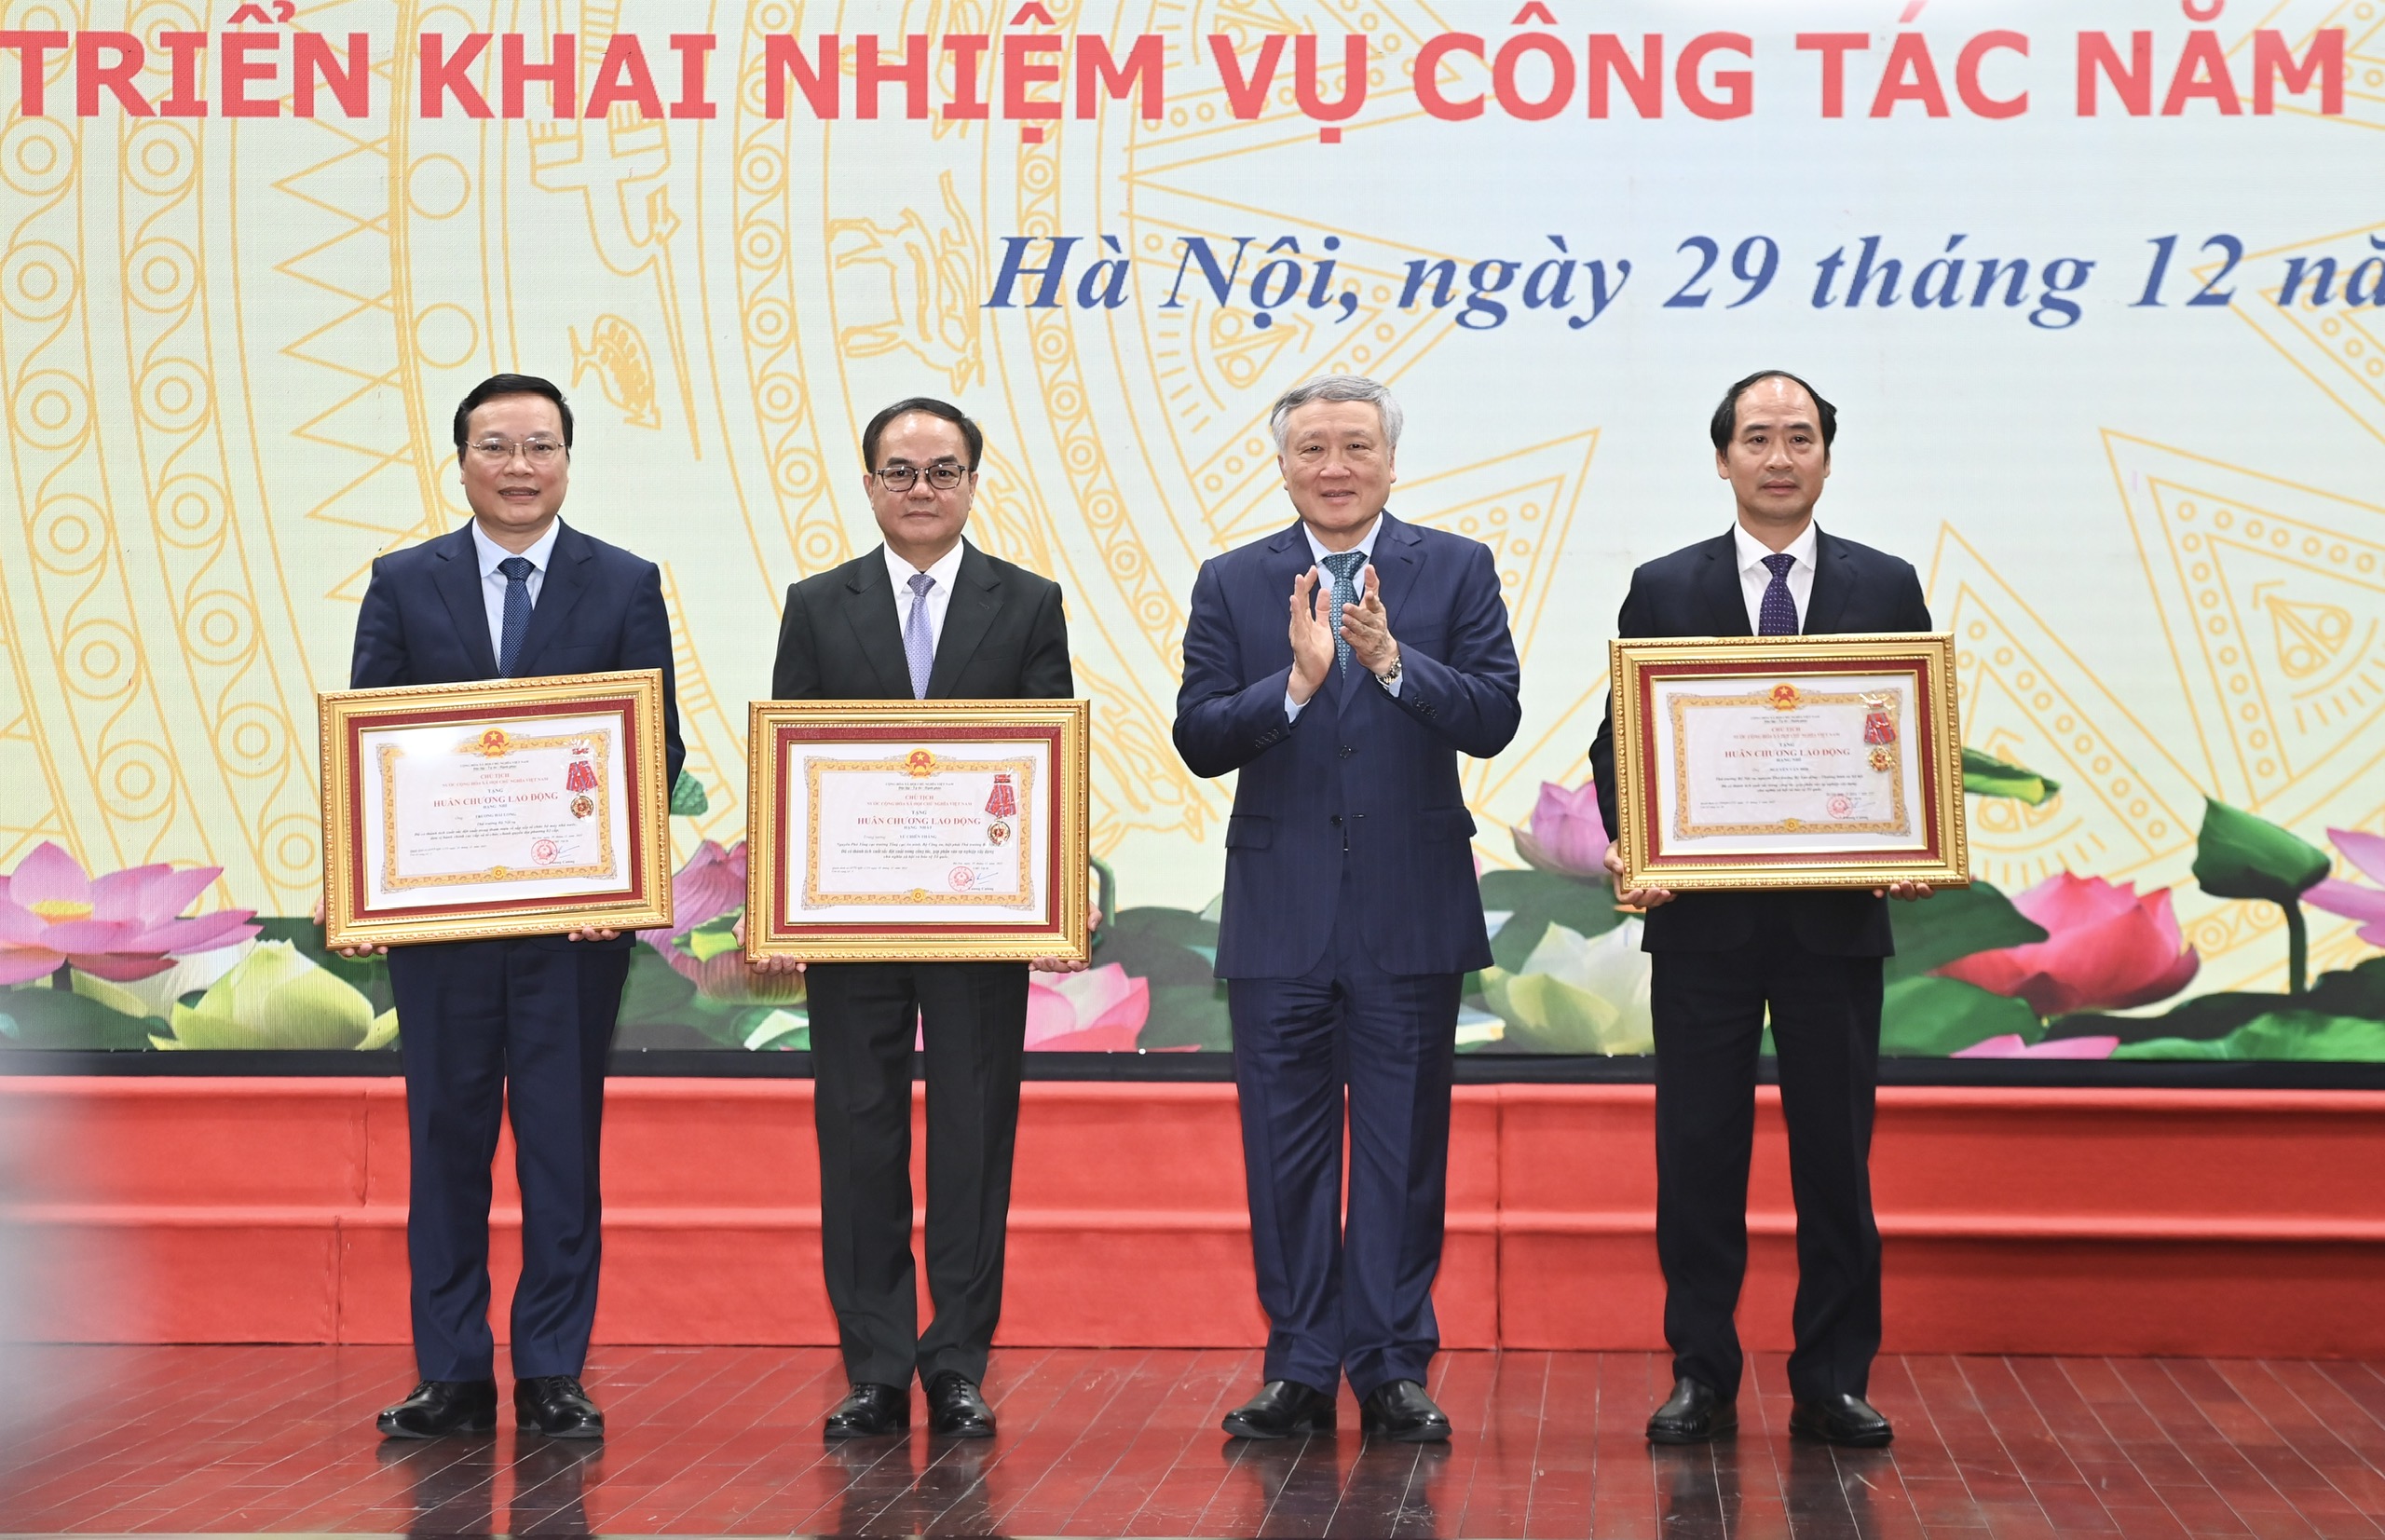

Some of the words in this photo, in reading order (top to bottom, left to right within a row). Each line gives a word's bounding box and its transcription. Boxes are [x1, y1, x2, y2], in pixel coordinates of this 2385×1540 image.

[0, 0, 370, 118] TRIỂN
[418, 33, 717, 119] KHAI
[764, 2, 1165, 143] NHIỆM
[1207, 34, 1369, 143] VỤ
[1411, 1, 1754, 121] CÔNG
[1795, 0, 2030, 119] TÁC
[2076, 0, 2346, 116] NĂM
[982, 234, 1130, 310] Hà
[1160, 235, 1359, 330] Nội,
[1397, 234, 1632, 330] ngày
[1662, 235, 1780, 309] 29
[1810, 234, 2096, 330] tháng
[2127, 234, 2245, 308] 12
[1724, 748, 1752, 758] HUÂN
[1754, 749, 1797, 757] CHƯƠNG
[1822, 748, 1850, 757] ĐỘNG
[433, 797, 460, 807] HUÂN
[463, 795, 506, 806] CHƯƠNG
[508, 794, 528, 803] LAO
[530, 791, 558, 802] ĐỘNG
[857, 815, 884, 825] HUÂN
[886, 816, 929, 825] CHƯƠNG
[931, 817, 951, 825] LAO
[953, 817, 981, 826] ĐỘNG
